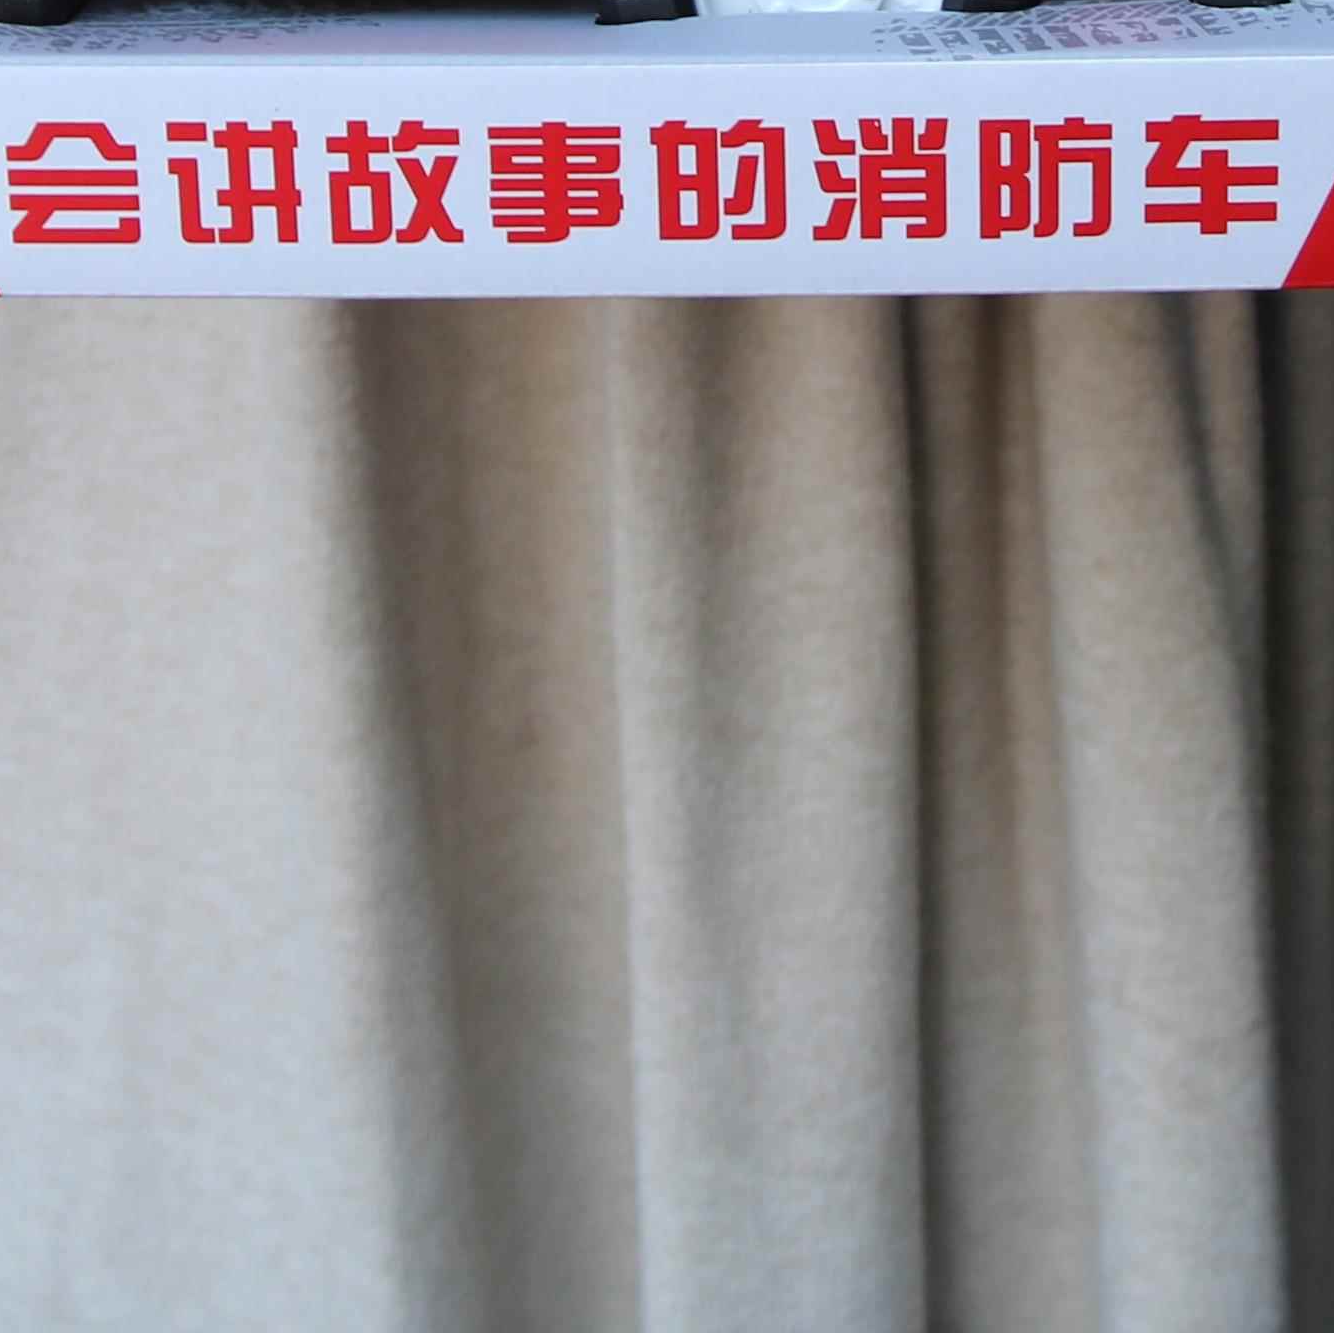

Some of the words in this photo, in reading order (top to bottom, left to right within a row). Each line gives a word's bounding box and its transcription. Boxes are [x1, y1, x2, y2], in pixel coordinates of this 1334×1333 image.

[6, 114, 1282, 245] 会讲故事的消防车
